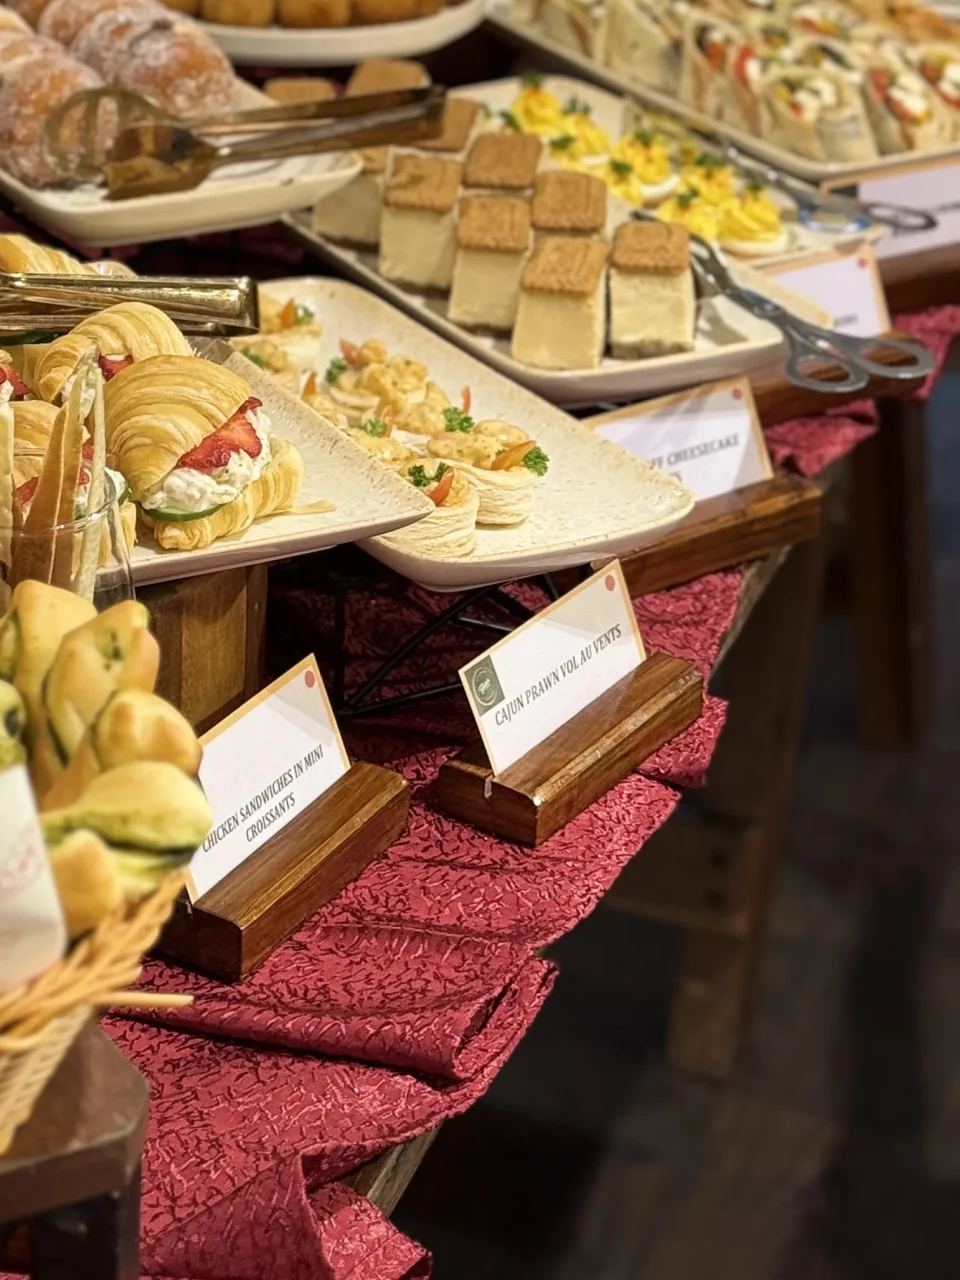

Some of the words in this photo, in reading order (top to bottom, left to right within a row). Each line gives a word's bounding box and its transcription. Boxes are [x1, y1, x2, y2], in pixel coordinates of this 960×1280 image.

[667, 433, 739, 466] CHEESECAKE
[495, 694, 525, 726] CAJUN
[525, 668, 560, 705] PRAWN
[560, 656, 580, 678] VOL
[580, 644, 592, 665] AU
[593, 623, 622, 655] VENTS
[202, 812, 240, 853] CHICKEN
[239, 769, 294, 822] SANDWICHES
[293, 760, 304, 779] IN
[303, 743, 324, 771] MINI
[245, 792, 296, 843] CROISSANTS
